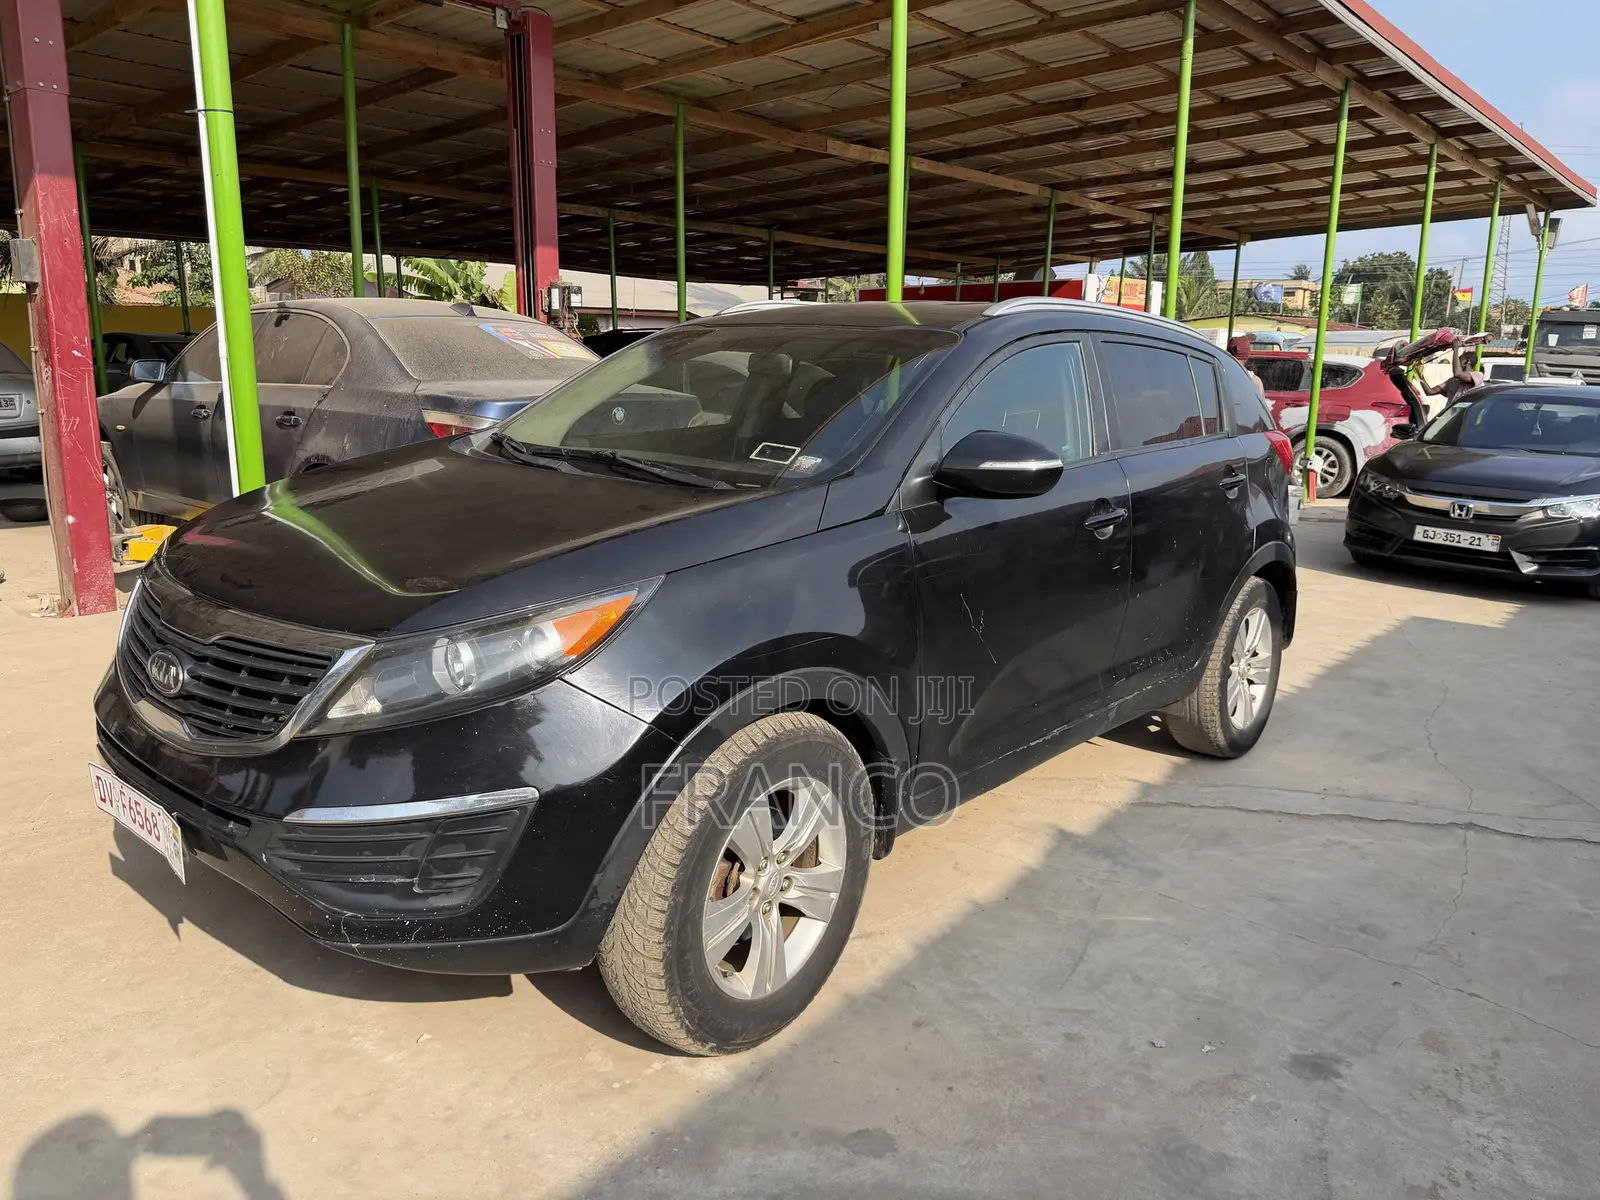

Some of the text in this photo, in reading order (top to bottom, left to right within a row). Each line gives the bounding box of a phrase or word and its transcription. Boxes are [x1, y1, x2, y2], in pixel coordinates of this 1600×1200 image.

[1422, 529, 1482, 547] GJ 351-21
[152, 657, 177, 689] KIA
